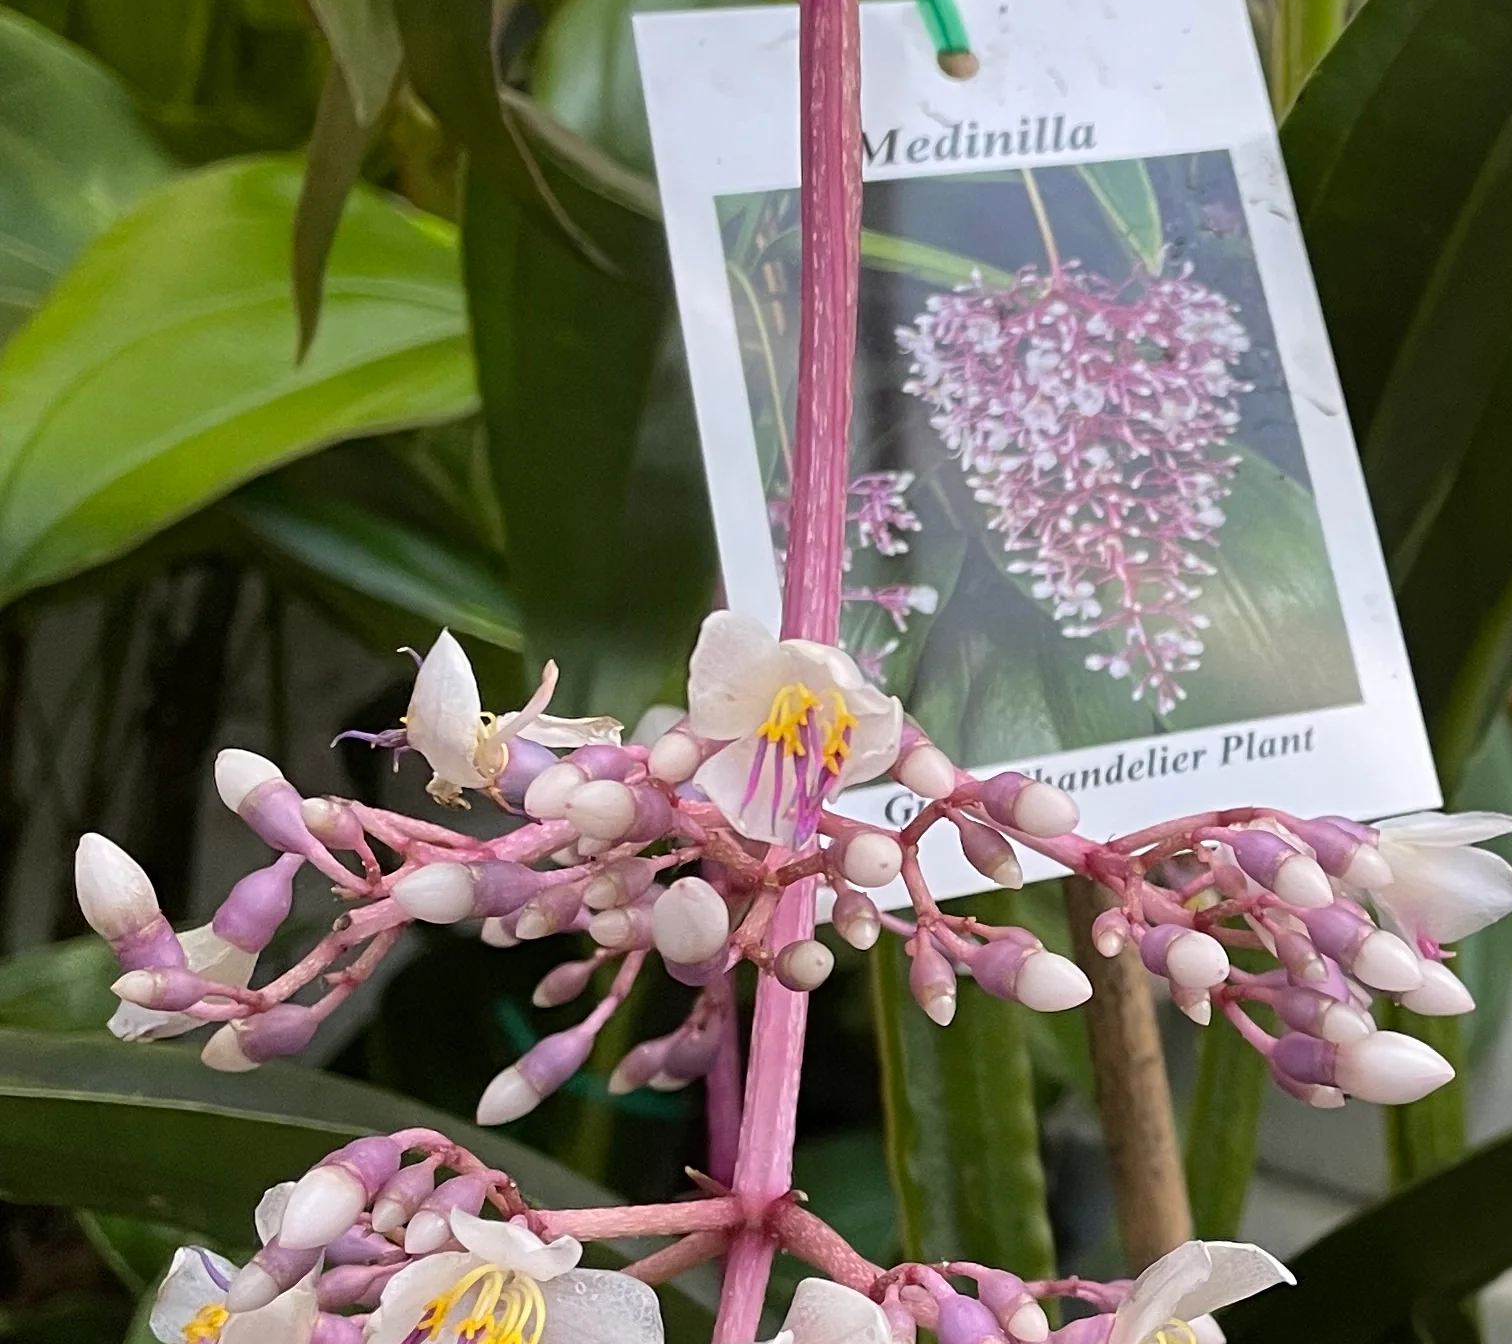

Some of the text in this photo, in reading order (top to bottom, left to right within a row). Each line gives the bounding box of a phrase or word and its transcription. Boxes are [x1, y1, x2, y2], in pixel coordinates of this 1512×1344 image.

[861, 115, 1096, 166] Medinilla
[1024, 725, 1316, 794] handelier Plant
